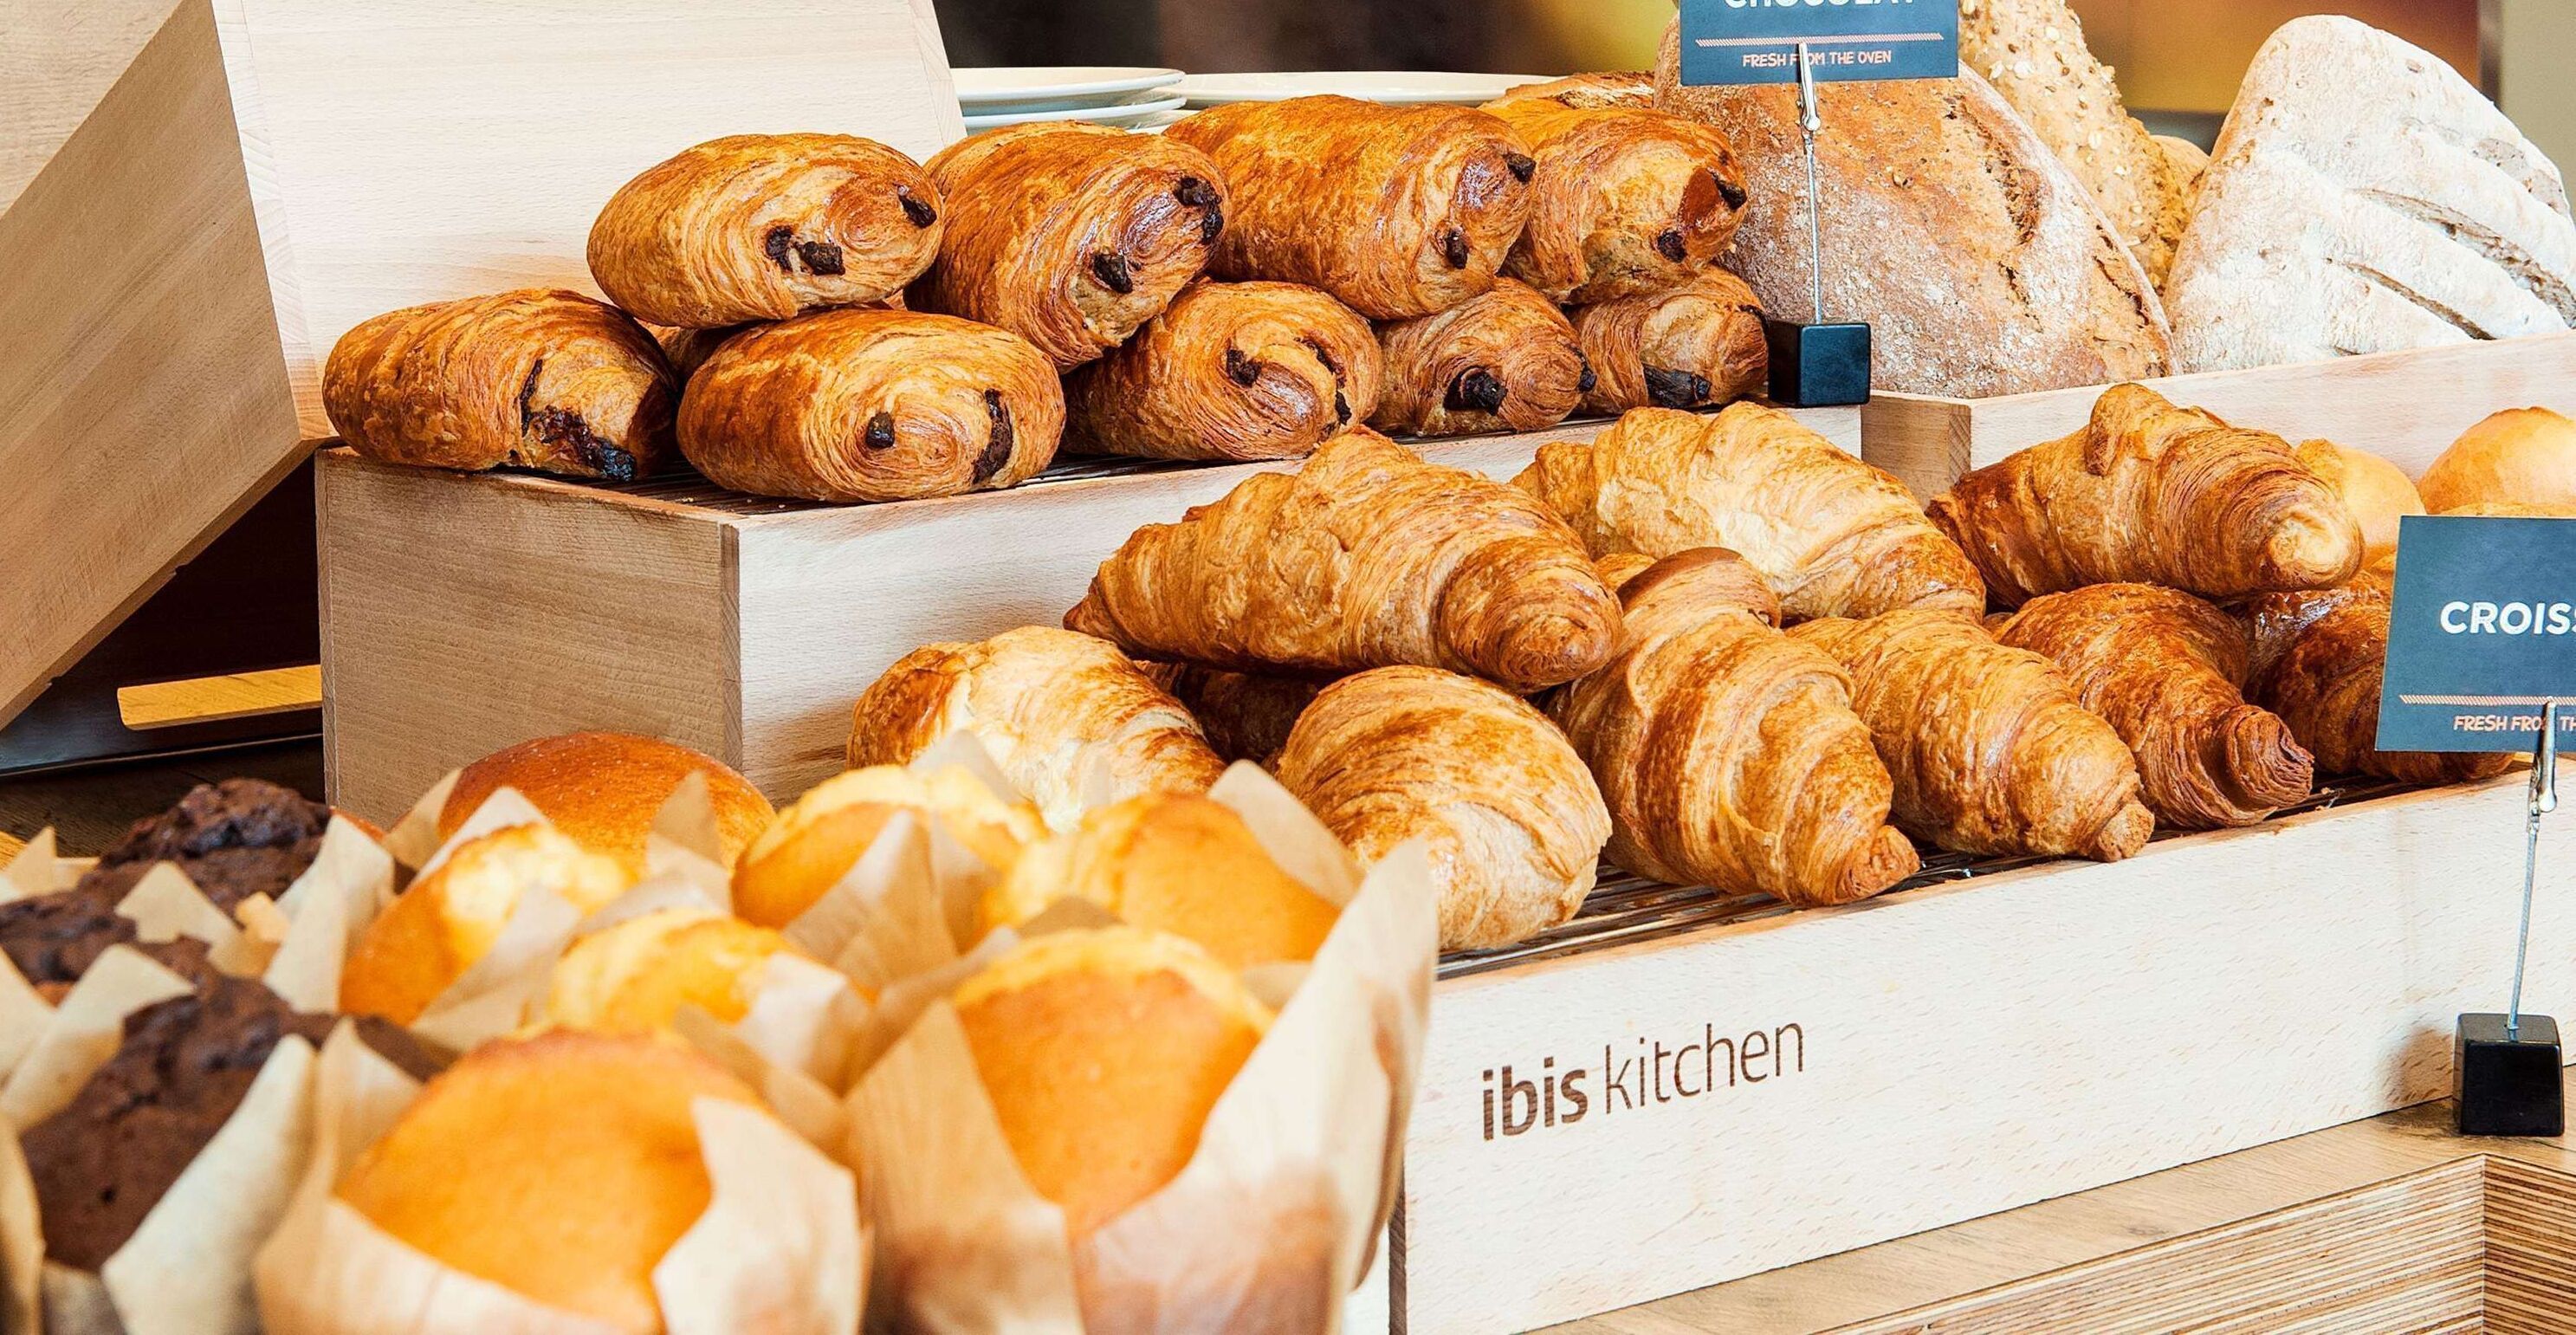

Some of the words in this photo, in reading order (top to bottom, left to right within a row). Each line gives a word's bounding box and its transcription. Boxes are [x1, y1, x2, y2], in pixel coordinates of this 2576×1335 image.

[1742, 52, 1787, 68] FRESH
[1790, 51, 1826, 67] FOM
[1828, 50, 1854, 65] THE
[1857, 49, 1893, 64] OVEN
[2439, 600, 2576, 635] CROIS
[2452, 714, 2508, 732] FRESH
[1482, 1056, 1589, 1142] ibis
[1604, 1022, 1804, 1115] kitchen
